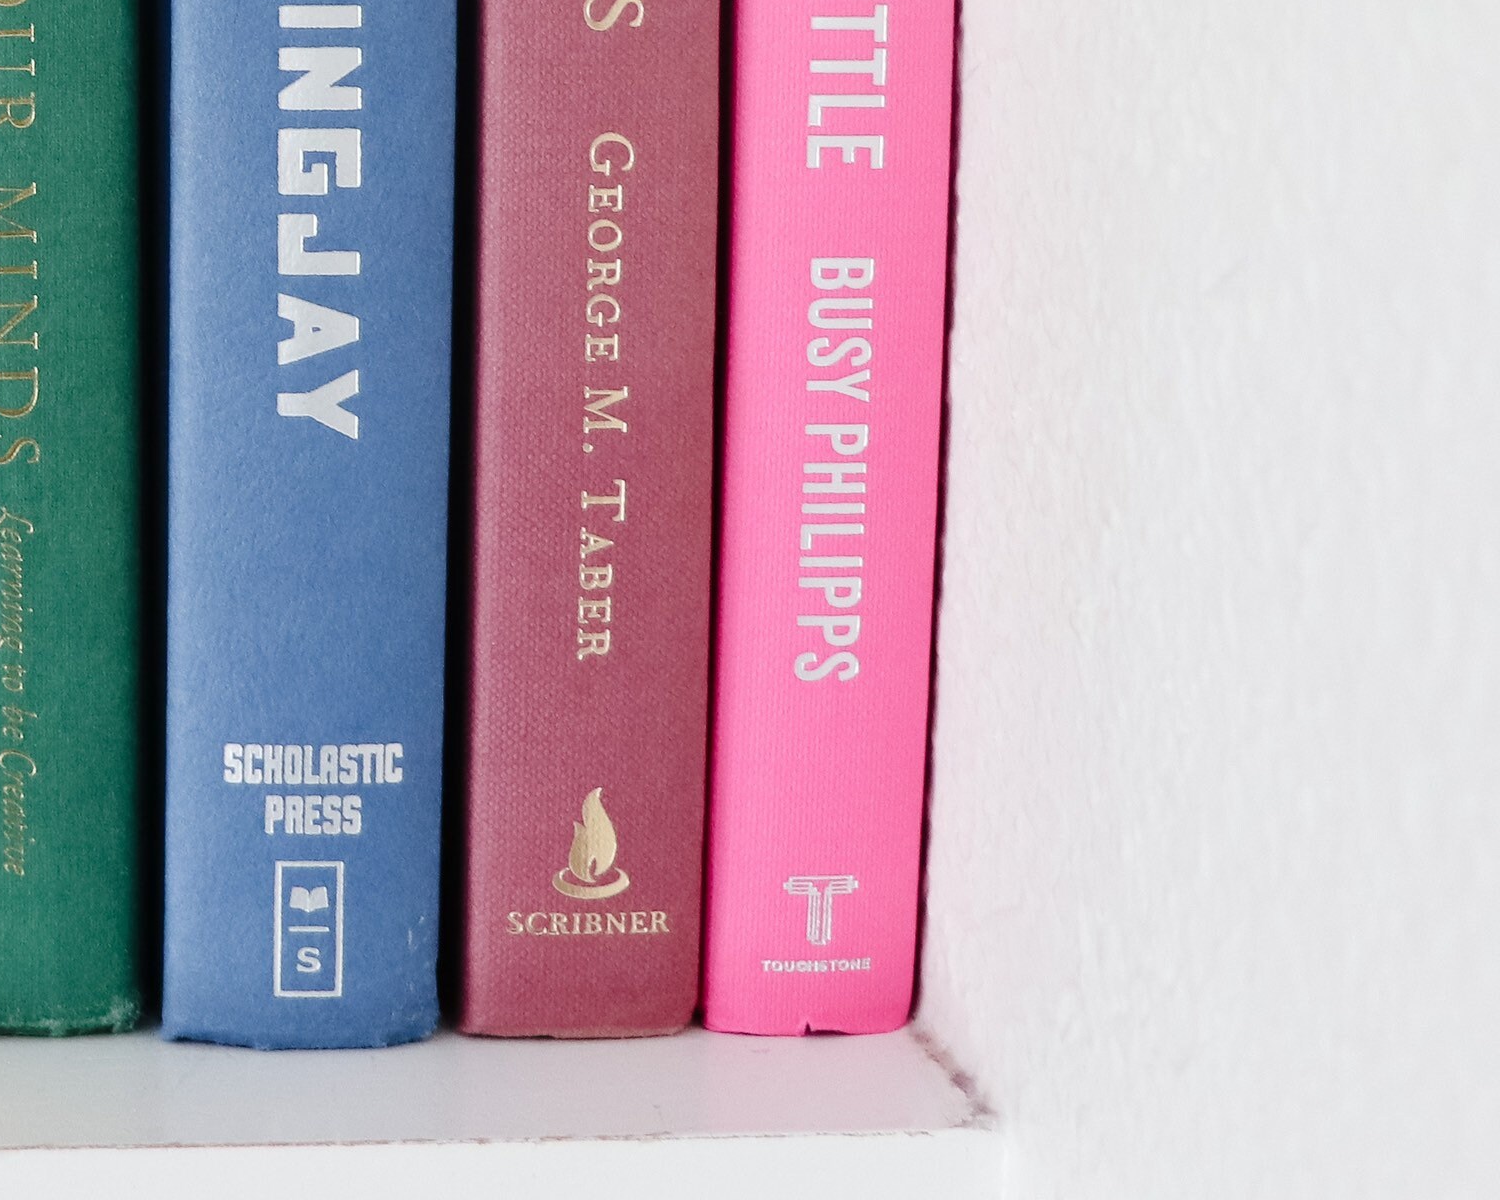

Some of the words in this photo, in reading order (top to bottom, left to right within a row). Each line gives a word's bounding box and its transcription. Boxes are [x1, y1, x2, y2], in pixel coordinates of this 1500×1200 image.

[584, 131, 635, 363] GEORGE
[806, 257, 874, 404] BUSY
[582, 385, 629, 454] M.
[577, 478, 626, 662] TABER
[793, 423, 869, 683] PHILIPPS
[1, 664, 27, 692] to
[2, 703, 39, 740] be
[223, 742, 404, 785] SCHOLASTIC
[264, 794, 362, 837] PRESS
[506, 911, 670, 936] SCRIBNER
[296, 945, 322, 975] S
[761, 957, 871, 973] TOUCHSTONE
